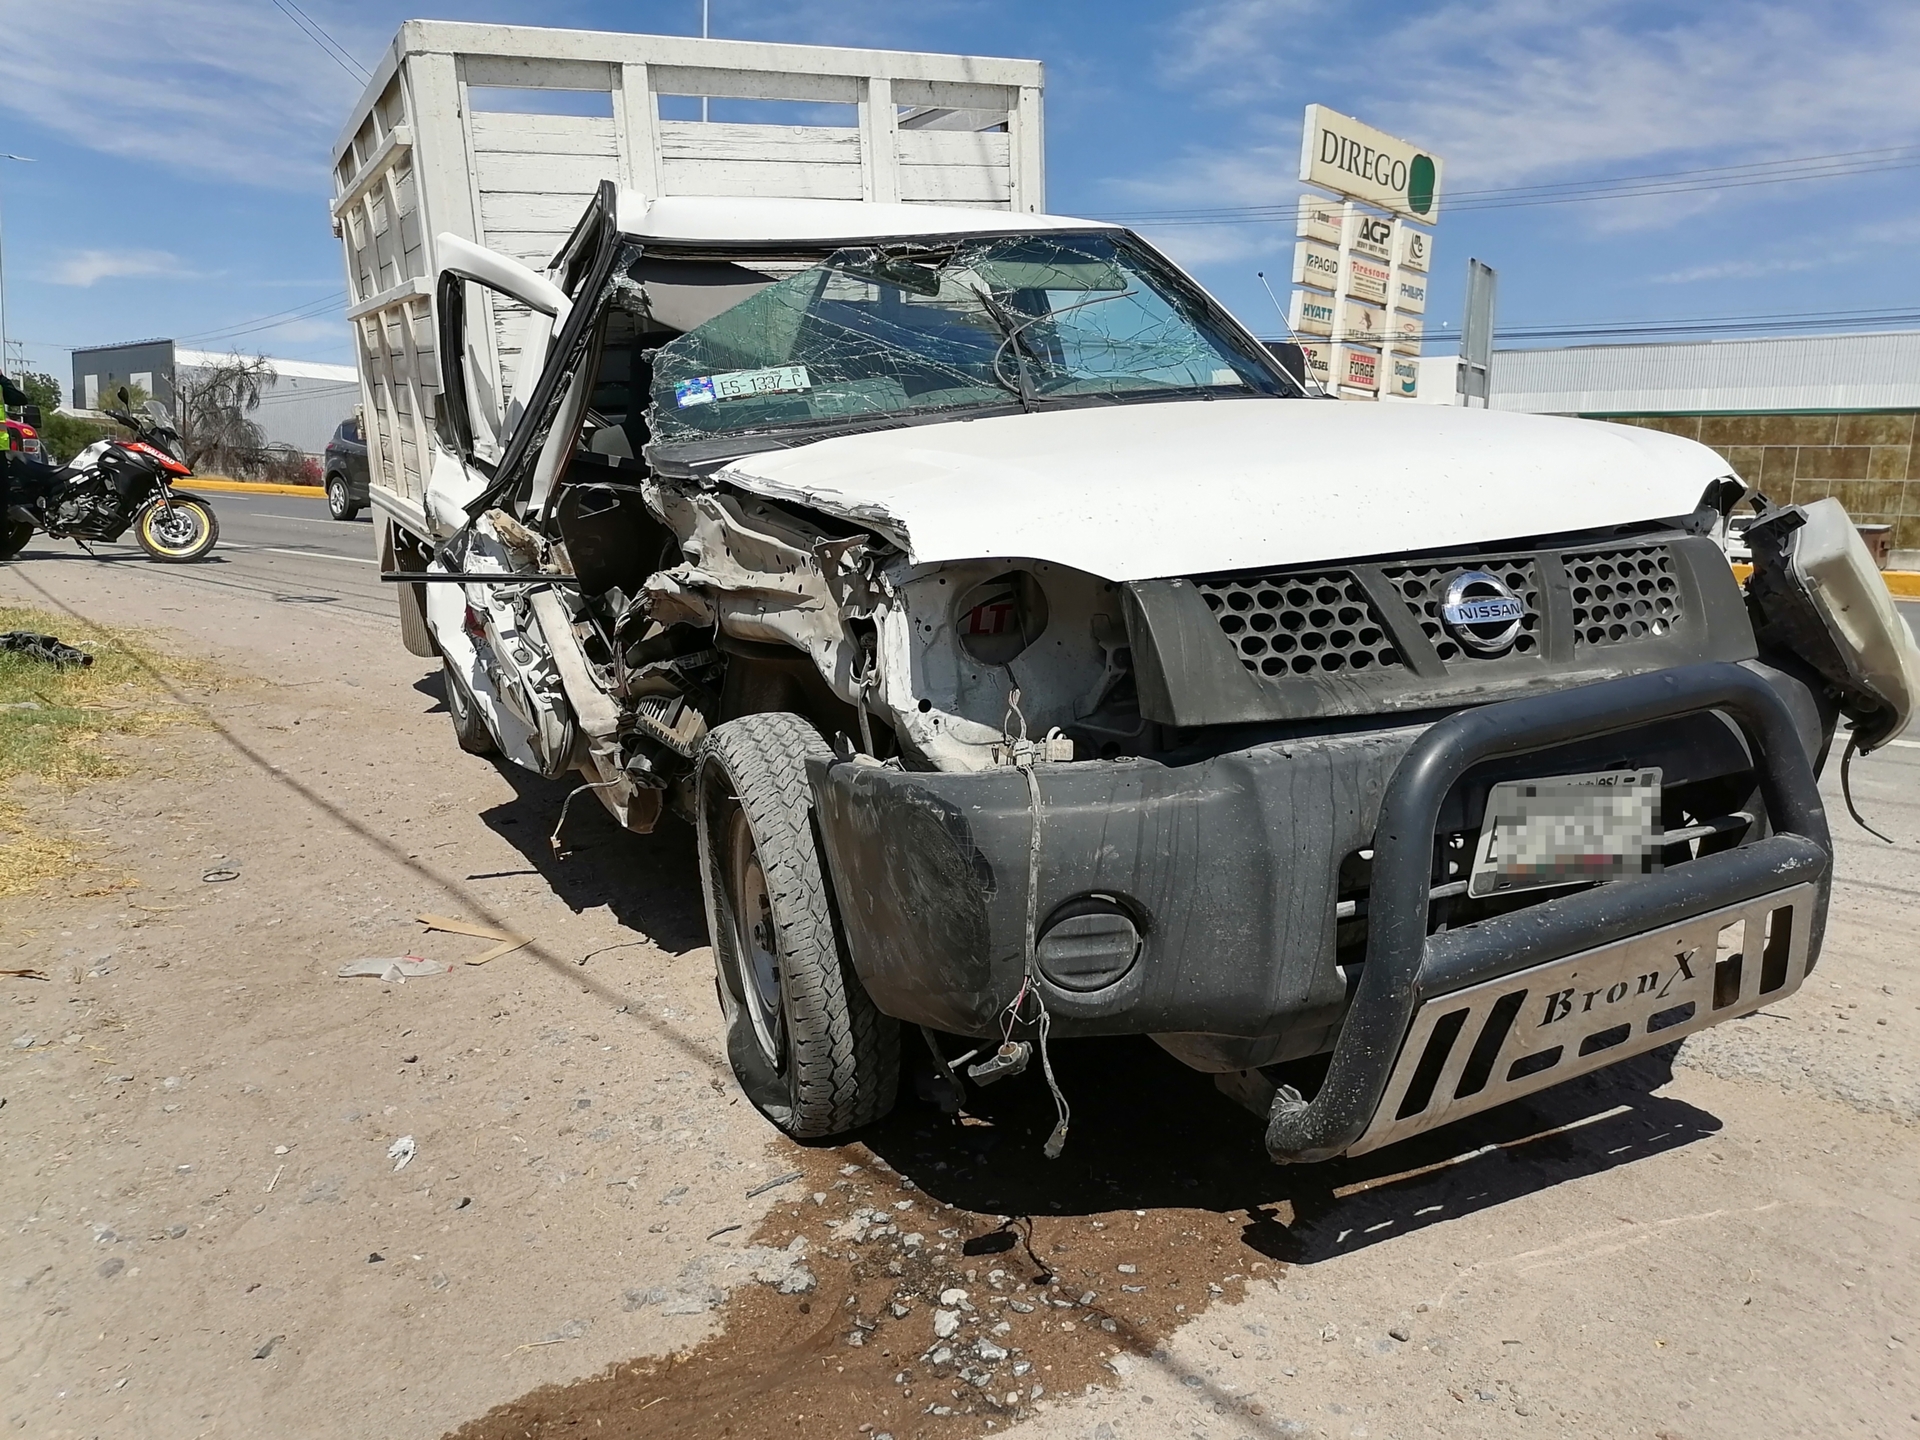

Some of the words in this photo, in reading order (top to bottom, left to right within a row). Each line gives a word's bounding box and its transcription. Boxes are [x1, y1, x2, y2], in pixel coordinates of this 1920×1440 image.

[1320, 128, 1407, 192] DIREGO
[1358, 217, 1391, 245] ACP
[1314, 256, 1338, 274] PAGID
[1352, 260, 1391, 281] Firestone
[1302, 303, 1333, 321] HYATT
[1349, 361, 1375, 378] FORGE
[144, 444, 176, 465] VIALIDAD
[1459, 603, 1520, 620] NISSAN
